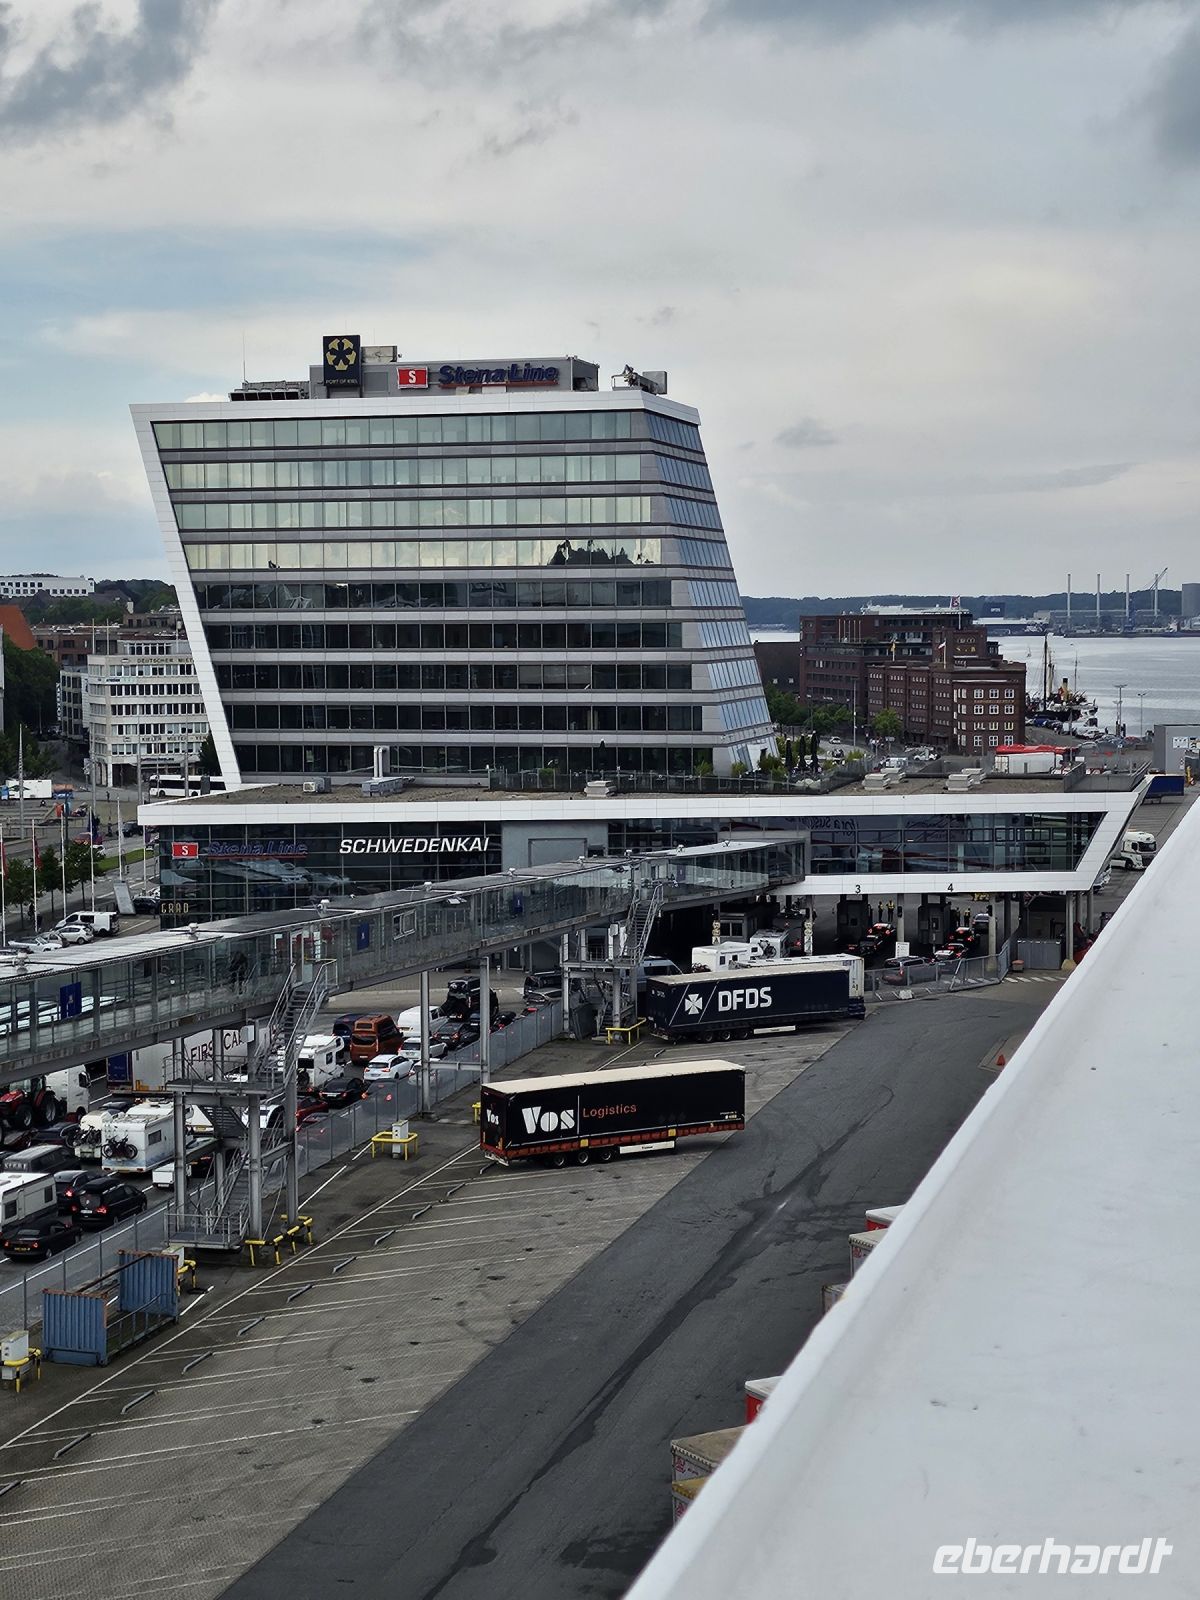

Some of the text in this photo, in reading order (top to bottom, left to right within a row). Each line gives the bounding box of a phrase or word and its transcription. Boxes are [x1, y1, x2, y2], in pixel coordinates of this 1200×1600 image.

[408, 370, 416, 384] S
[438, 363, 559, 384] Stena Line
[181, 845, 188, 856] S
[208, 840, 308, 856] Stena Line
[339, 836, 489, 854] SCHWEDENKAI
[855, 884, 862, 894] 3
[947, 883, 954, 892] 4
[161, 902, 189, 914] GRAD
[717, 986, 773, 1012] DFDS
[486, 1108, 499, 1125] Vos
[521, 1104, 637, 1134] Vos Logistics
